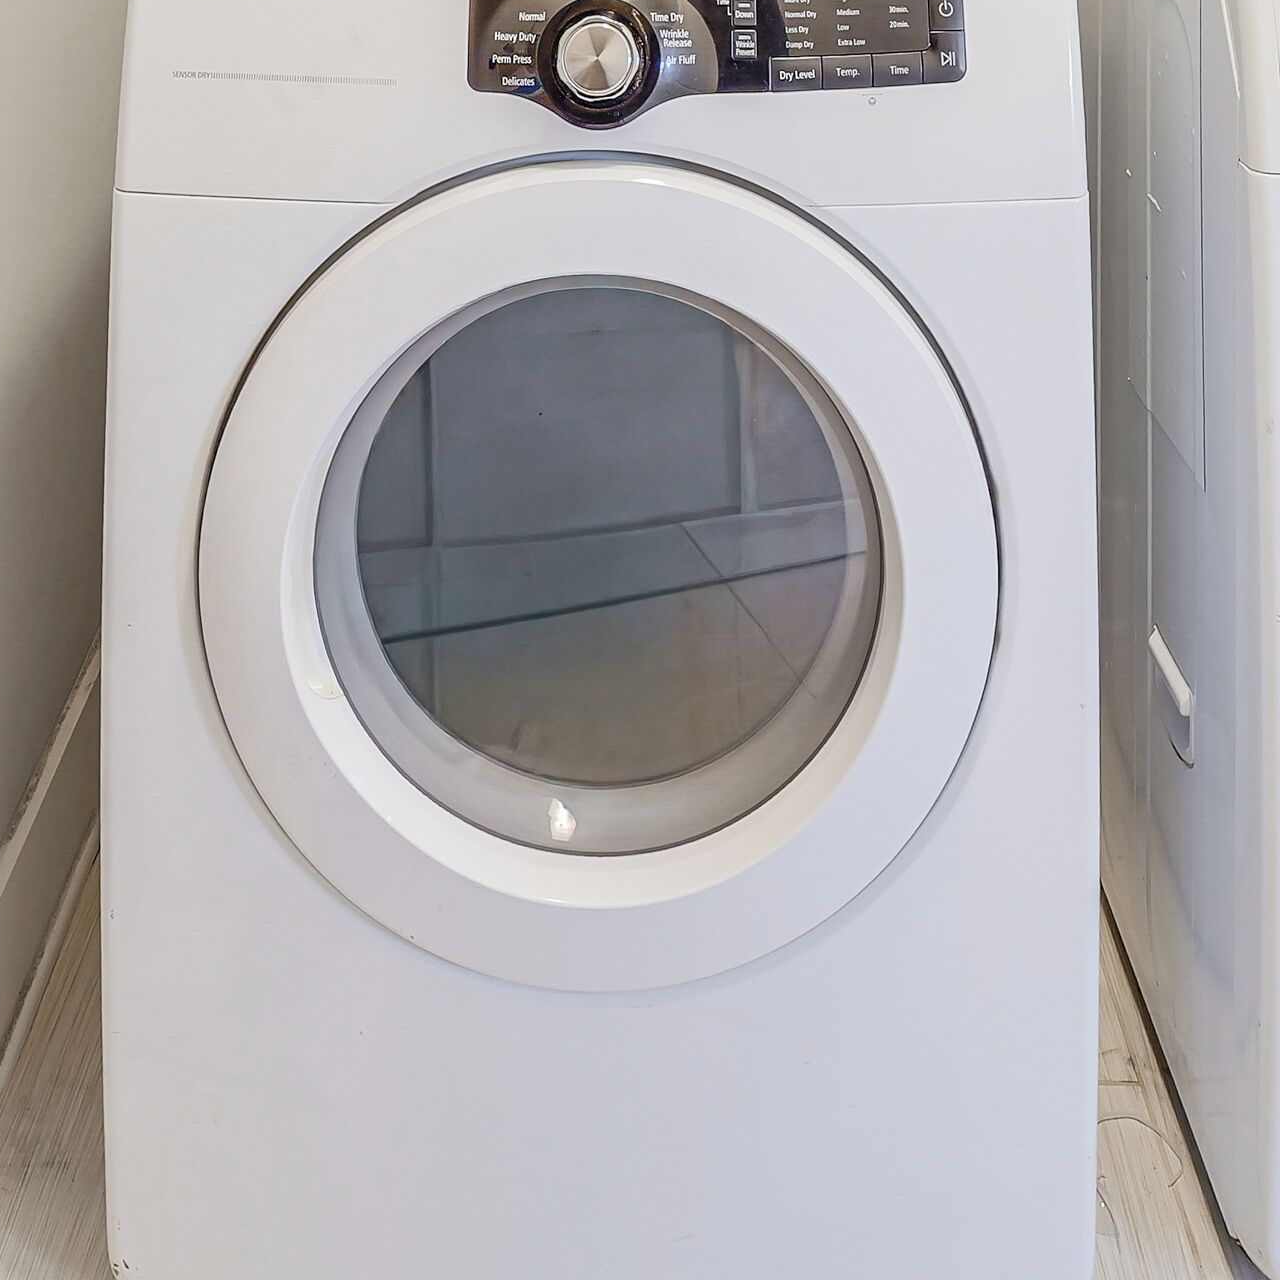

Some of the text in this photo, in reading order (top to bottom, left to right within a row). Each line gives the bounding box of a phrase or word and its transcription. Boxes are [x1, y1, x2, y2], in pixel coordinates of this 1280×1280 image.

[519, 11, 546, 21] Normal
[650, 13, 684, 24] Time Dry
[735, 11, 754, 19] Down
[807, 10, 817, 19] Dry
[660, 29, 689, 38] Wrinkle
[799, 26, 809, 34] Dry
[494, 31, 536, 44] Heavy Duty
[663, 39, 692, 48] Release
[803, 40, 814, 49] Dry
[492, 54, 532, 64] Perm Press
[666, 55, 696, 64] Air Fluff
[836, 67, 860, 77] Temp.
[890, 65, 909, 74] Time
[779, 69, 815, 82] Dry Level
[502, 76, 535, 86] Delicates
